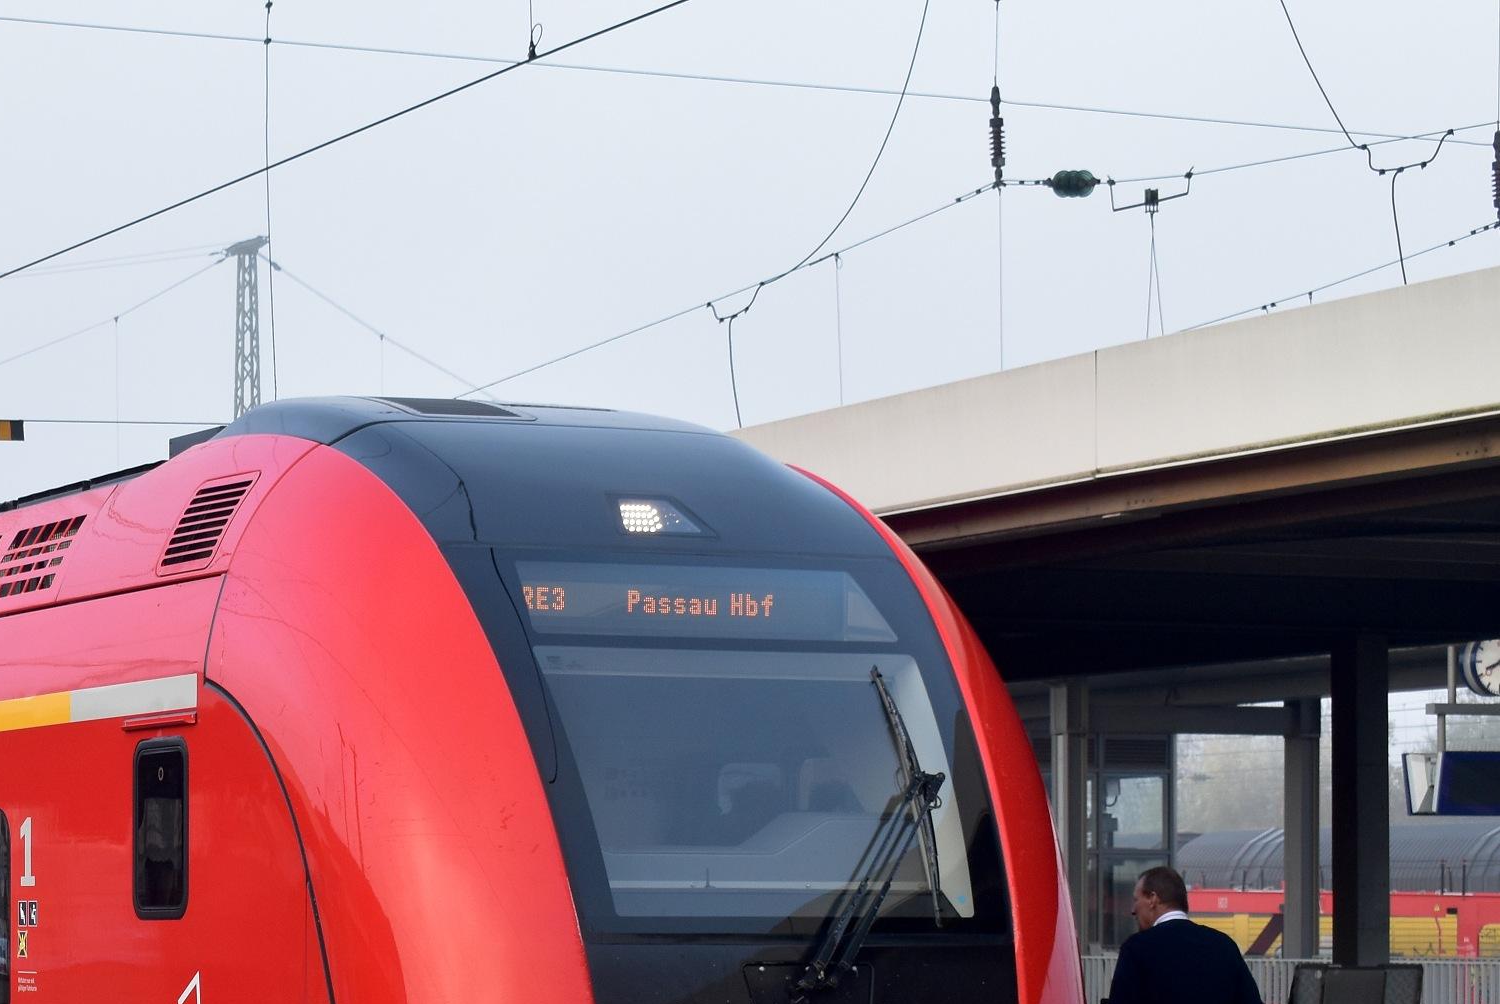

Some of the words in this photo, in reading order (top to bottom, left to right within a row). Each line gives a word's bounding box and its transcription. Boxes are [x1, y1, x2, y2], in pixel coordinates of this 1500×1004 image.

[523, 586, 565, 610] RE3
[627, 589, 717, 616] Passau
[729, 592, 775, 618] Hbf
[19, 816, 36, 887] 1
